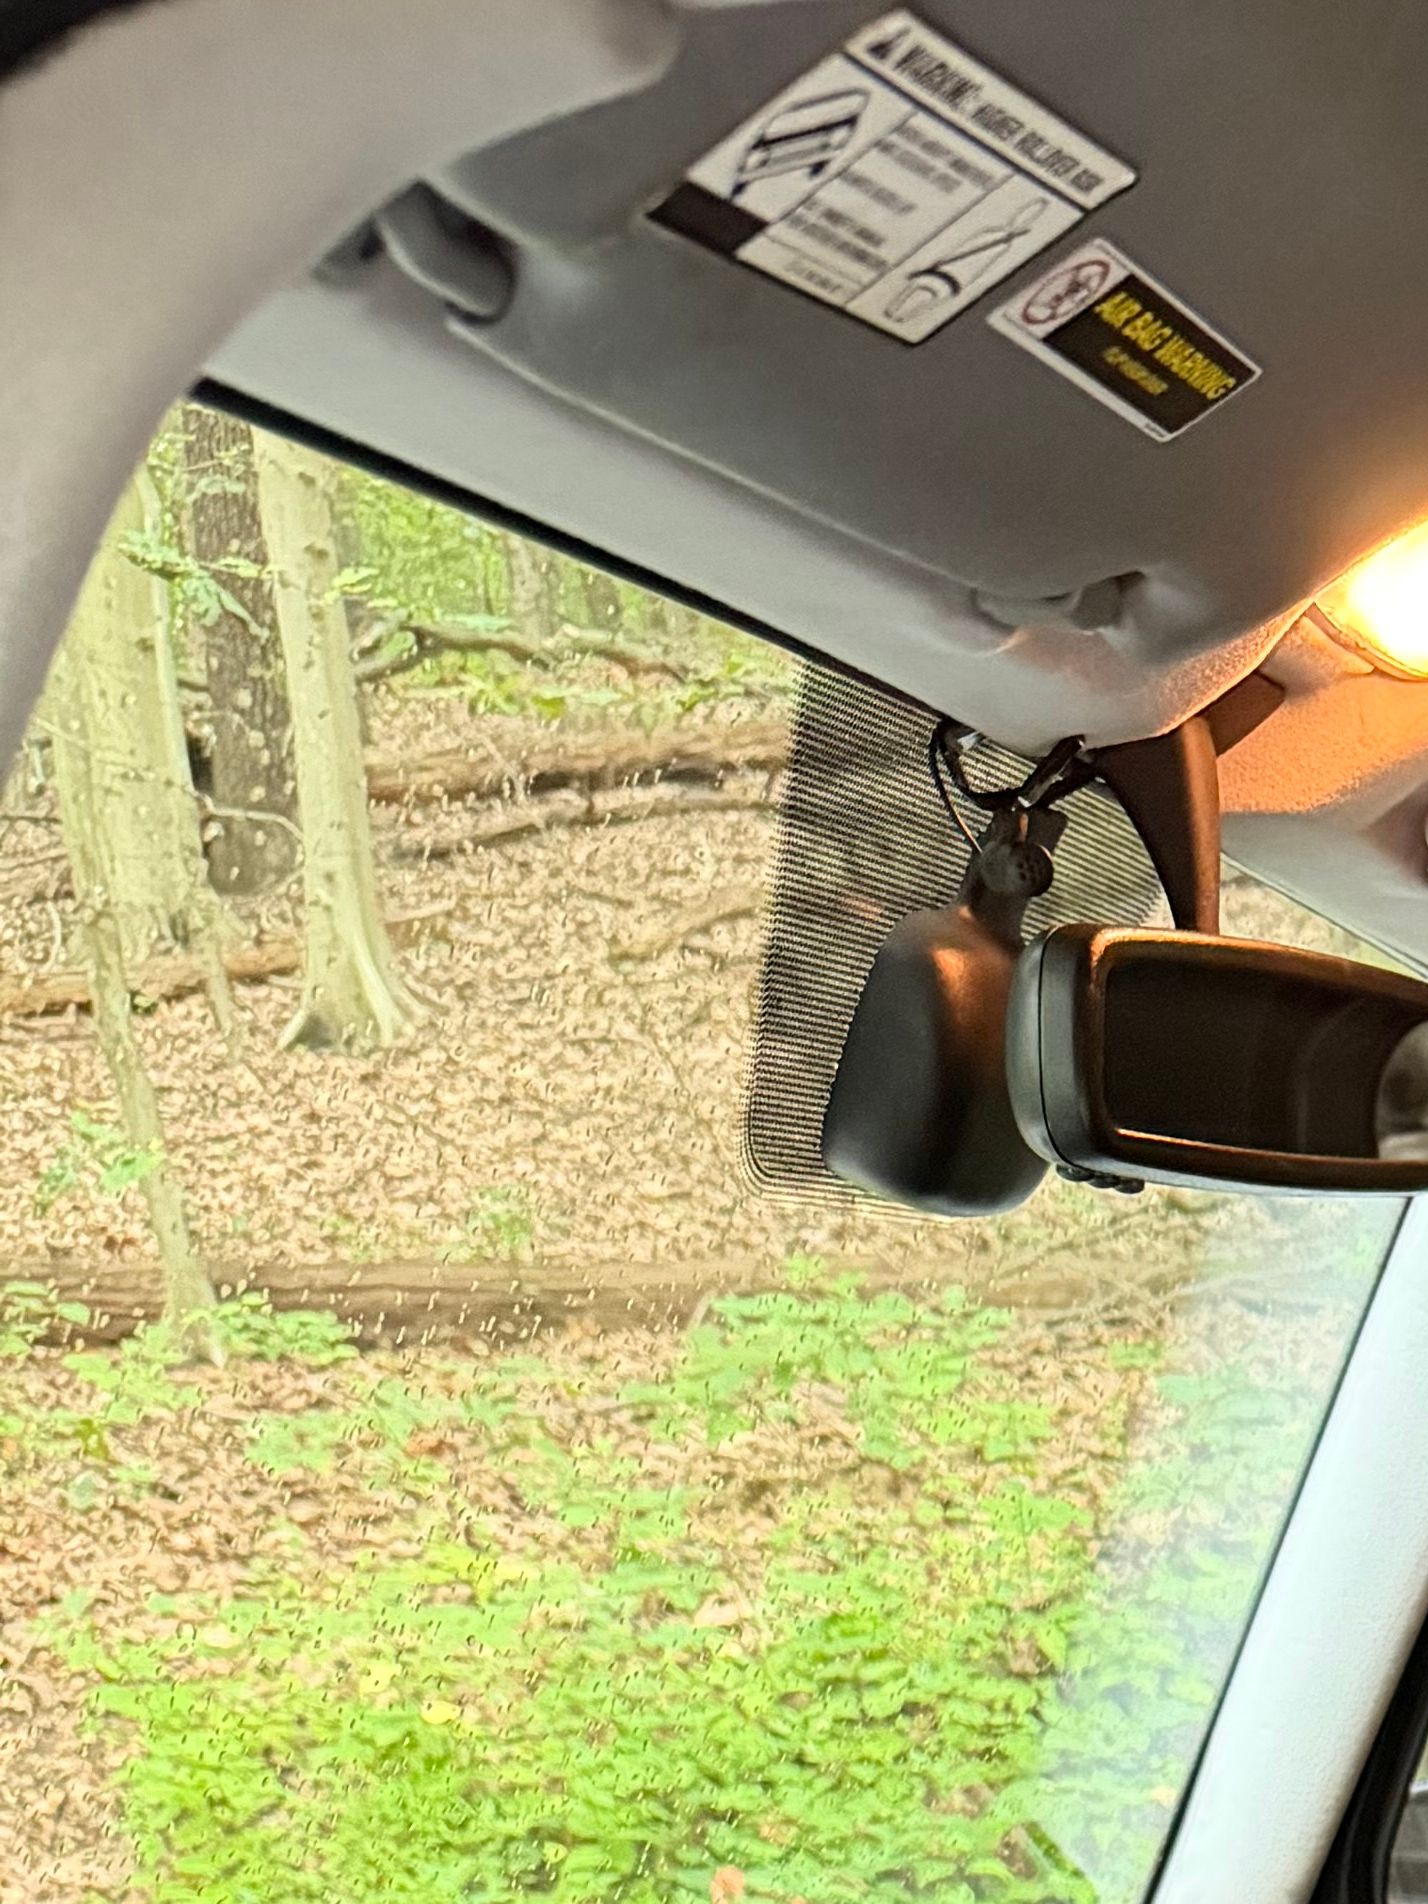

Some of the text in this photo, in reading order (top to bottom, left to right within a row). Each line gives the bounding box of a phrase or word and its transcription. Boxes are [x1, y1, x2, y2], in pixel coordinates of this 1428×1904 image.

[1093, 290, 1143, 330] AIR
[1121, 311, 1173, 352] BAG
[1153, 333, 1237, 401] WARNING
